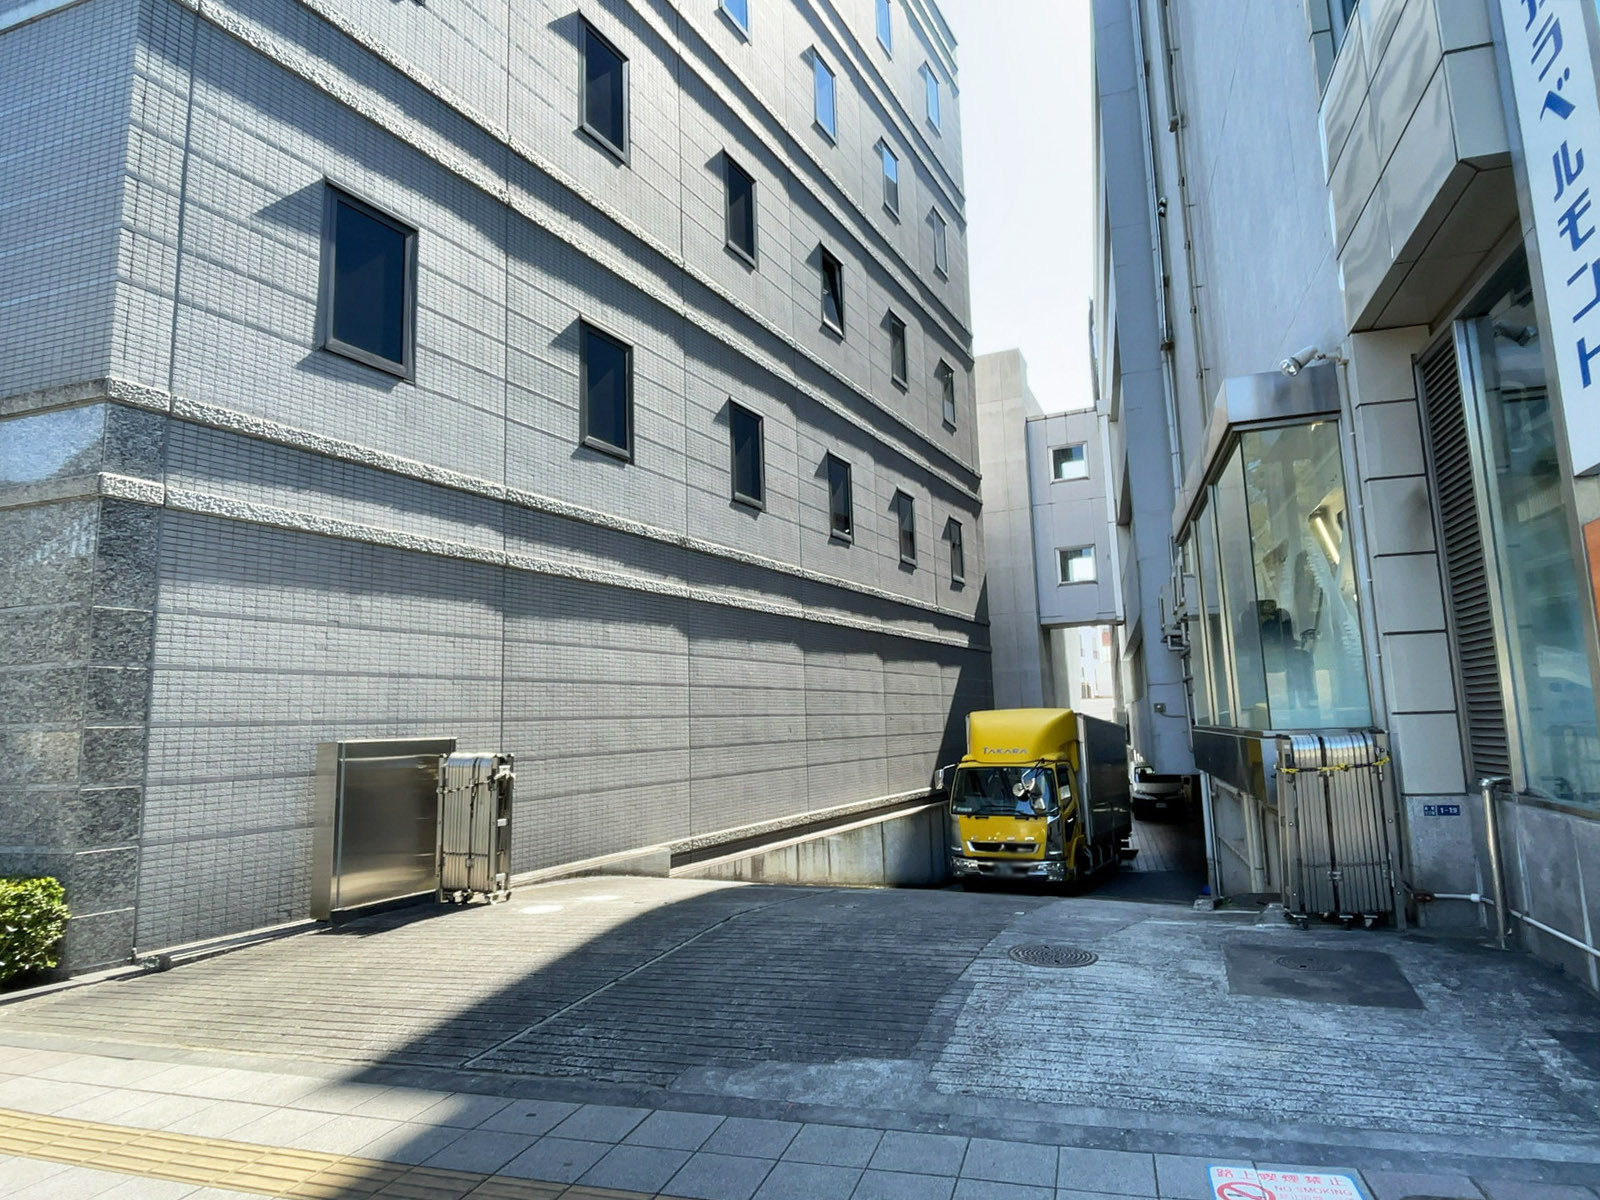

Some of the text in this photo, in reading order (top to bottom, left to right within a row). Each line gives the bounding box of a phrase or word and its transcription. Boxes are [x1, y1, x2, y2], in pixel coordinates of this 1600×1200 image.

[1216, 1168, 1344, 1187] 路上喫煙禁止
[1296, 1186, 1353, 1196] SMOKING
